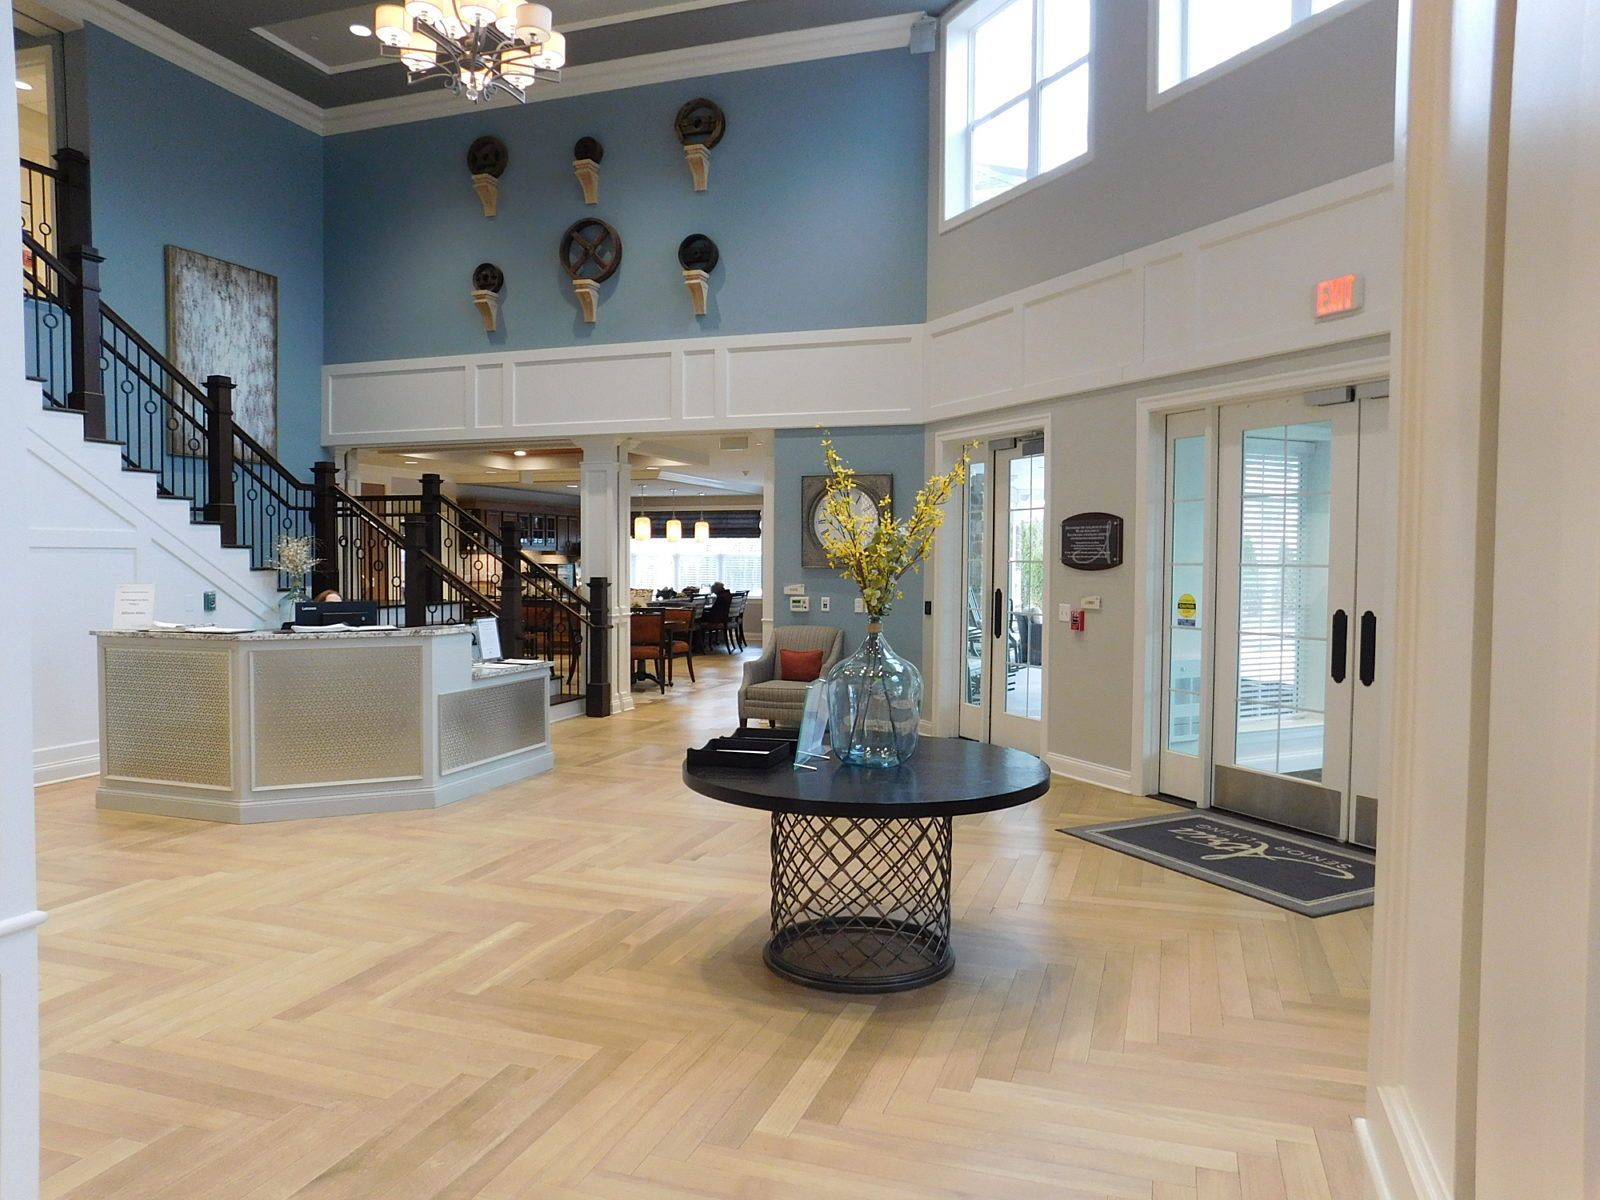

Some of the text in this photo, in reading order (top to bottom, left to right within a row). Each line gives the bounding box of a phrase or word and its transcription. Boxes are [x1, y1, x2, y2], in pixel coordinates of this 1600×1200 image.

[1316, 275, 1355, 316] EXIT
[1196, 824, 1352, 869] SENIOR LIVING
